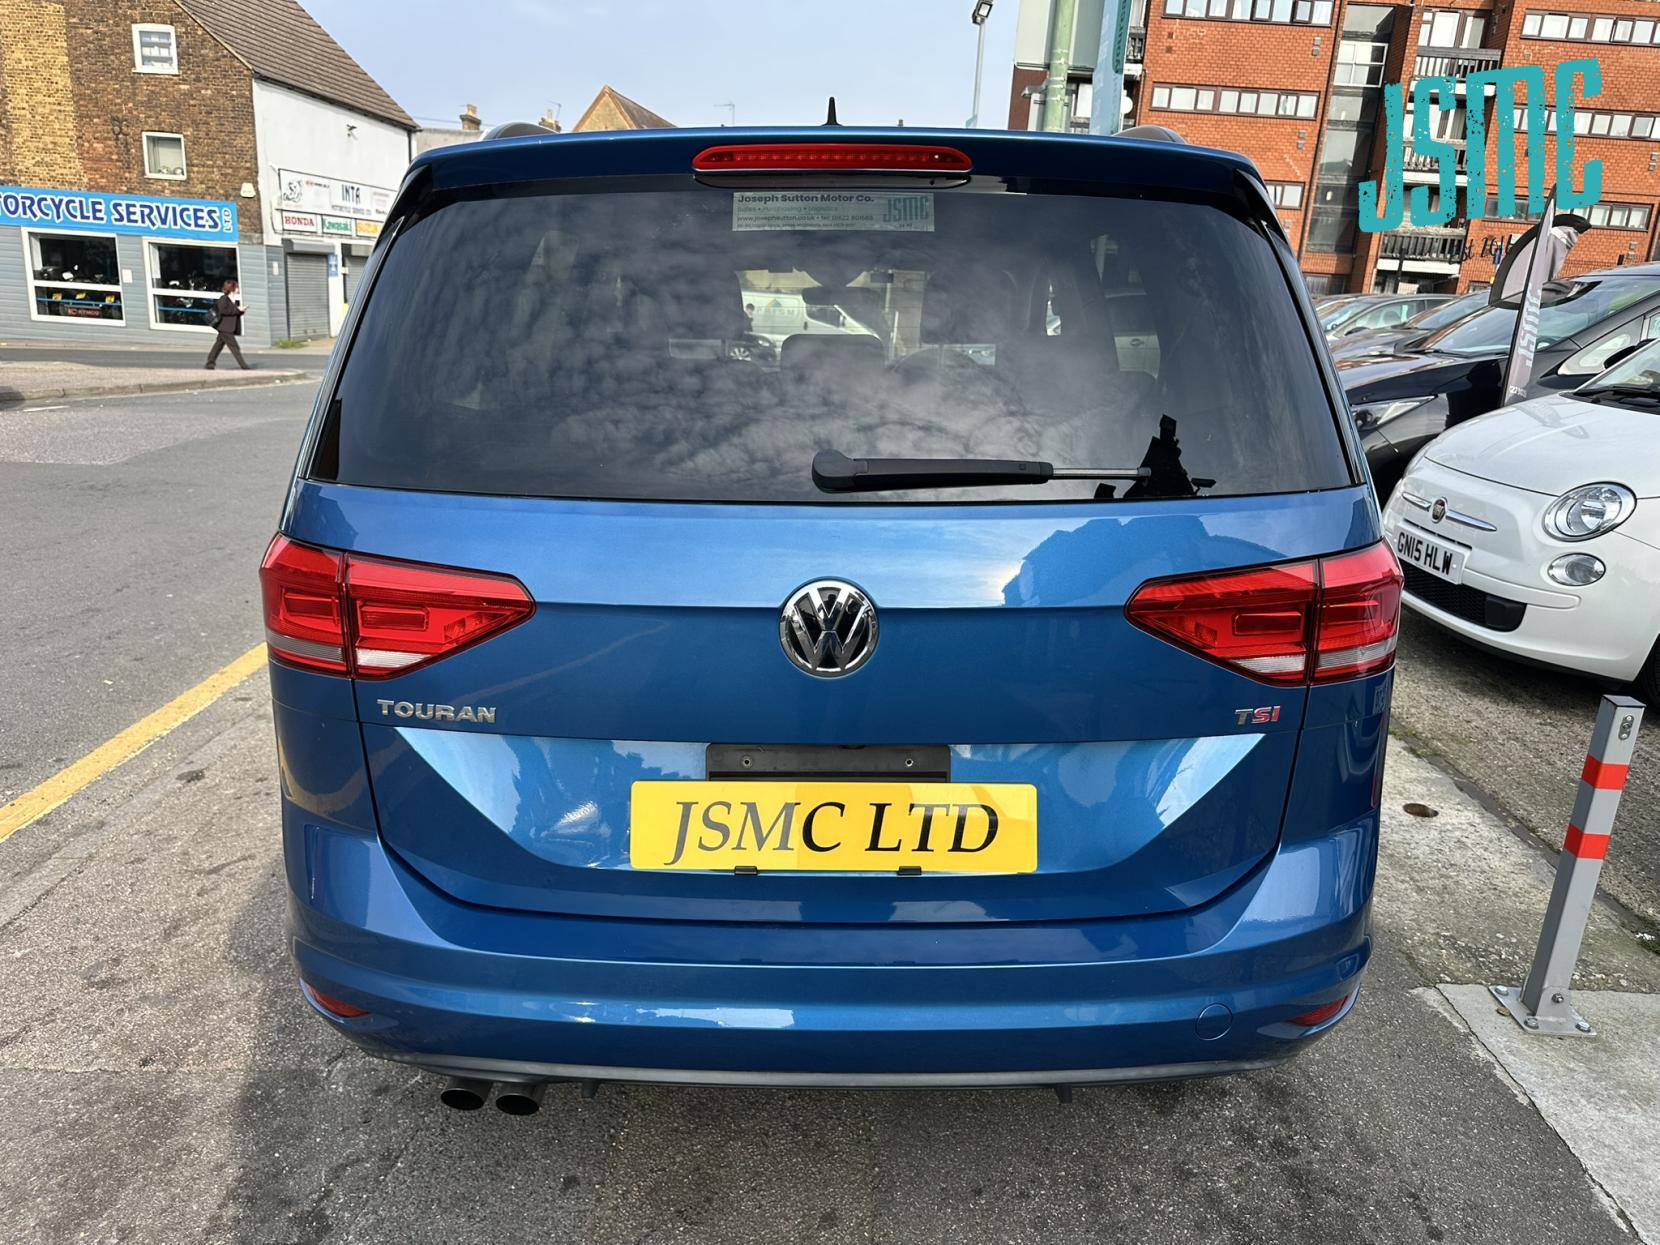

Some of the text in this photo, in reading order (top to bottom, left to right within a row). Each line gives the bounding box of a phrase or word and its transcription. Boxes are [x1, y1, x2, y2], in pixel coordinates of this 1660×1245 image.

[738, 194, 875, 204] Joseph Sutton Motor Co.
[883, 196, 929, 223] JSMC
[112, 202, 220, 230] SERVICES
[222, 208, 232, 232] LTD
[284, 215, 315, 227] HONDA
[1397, 531, 1453, 575] GN15 HLW
[376, 698, 497, 723] TOURAN
[1234, 705, 1281, 726] TSI
[664, 800, 999, 866] JSMC LTD
